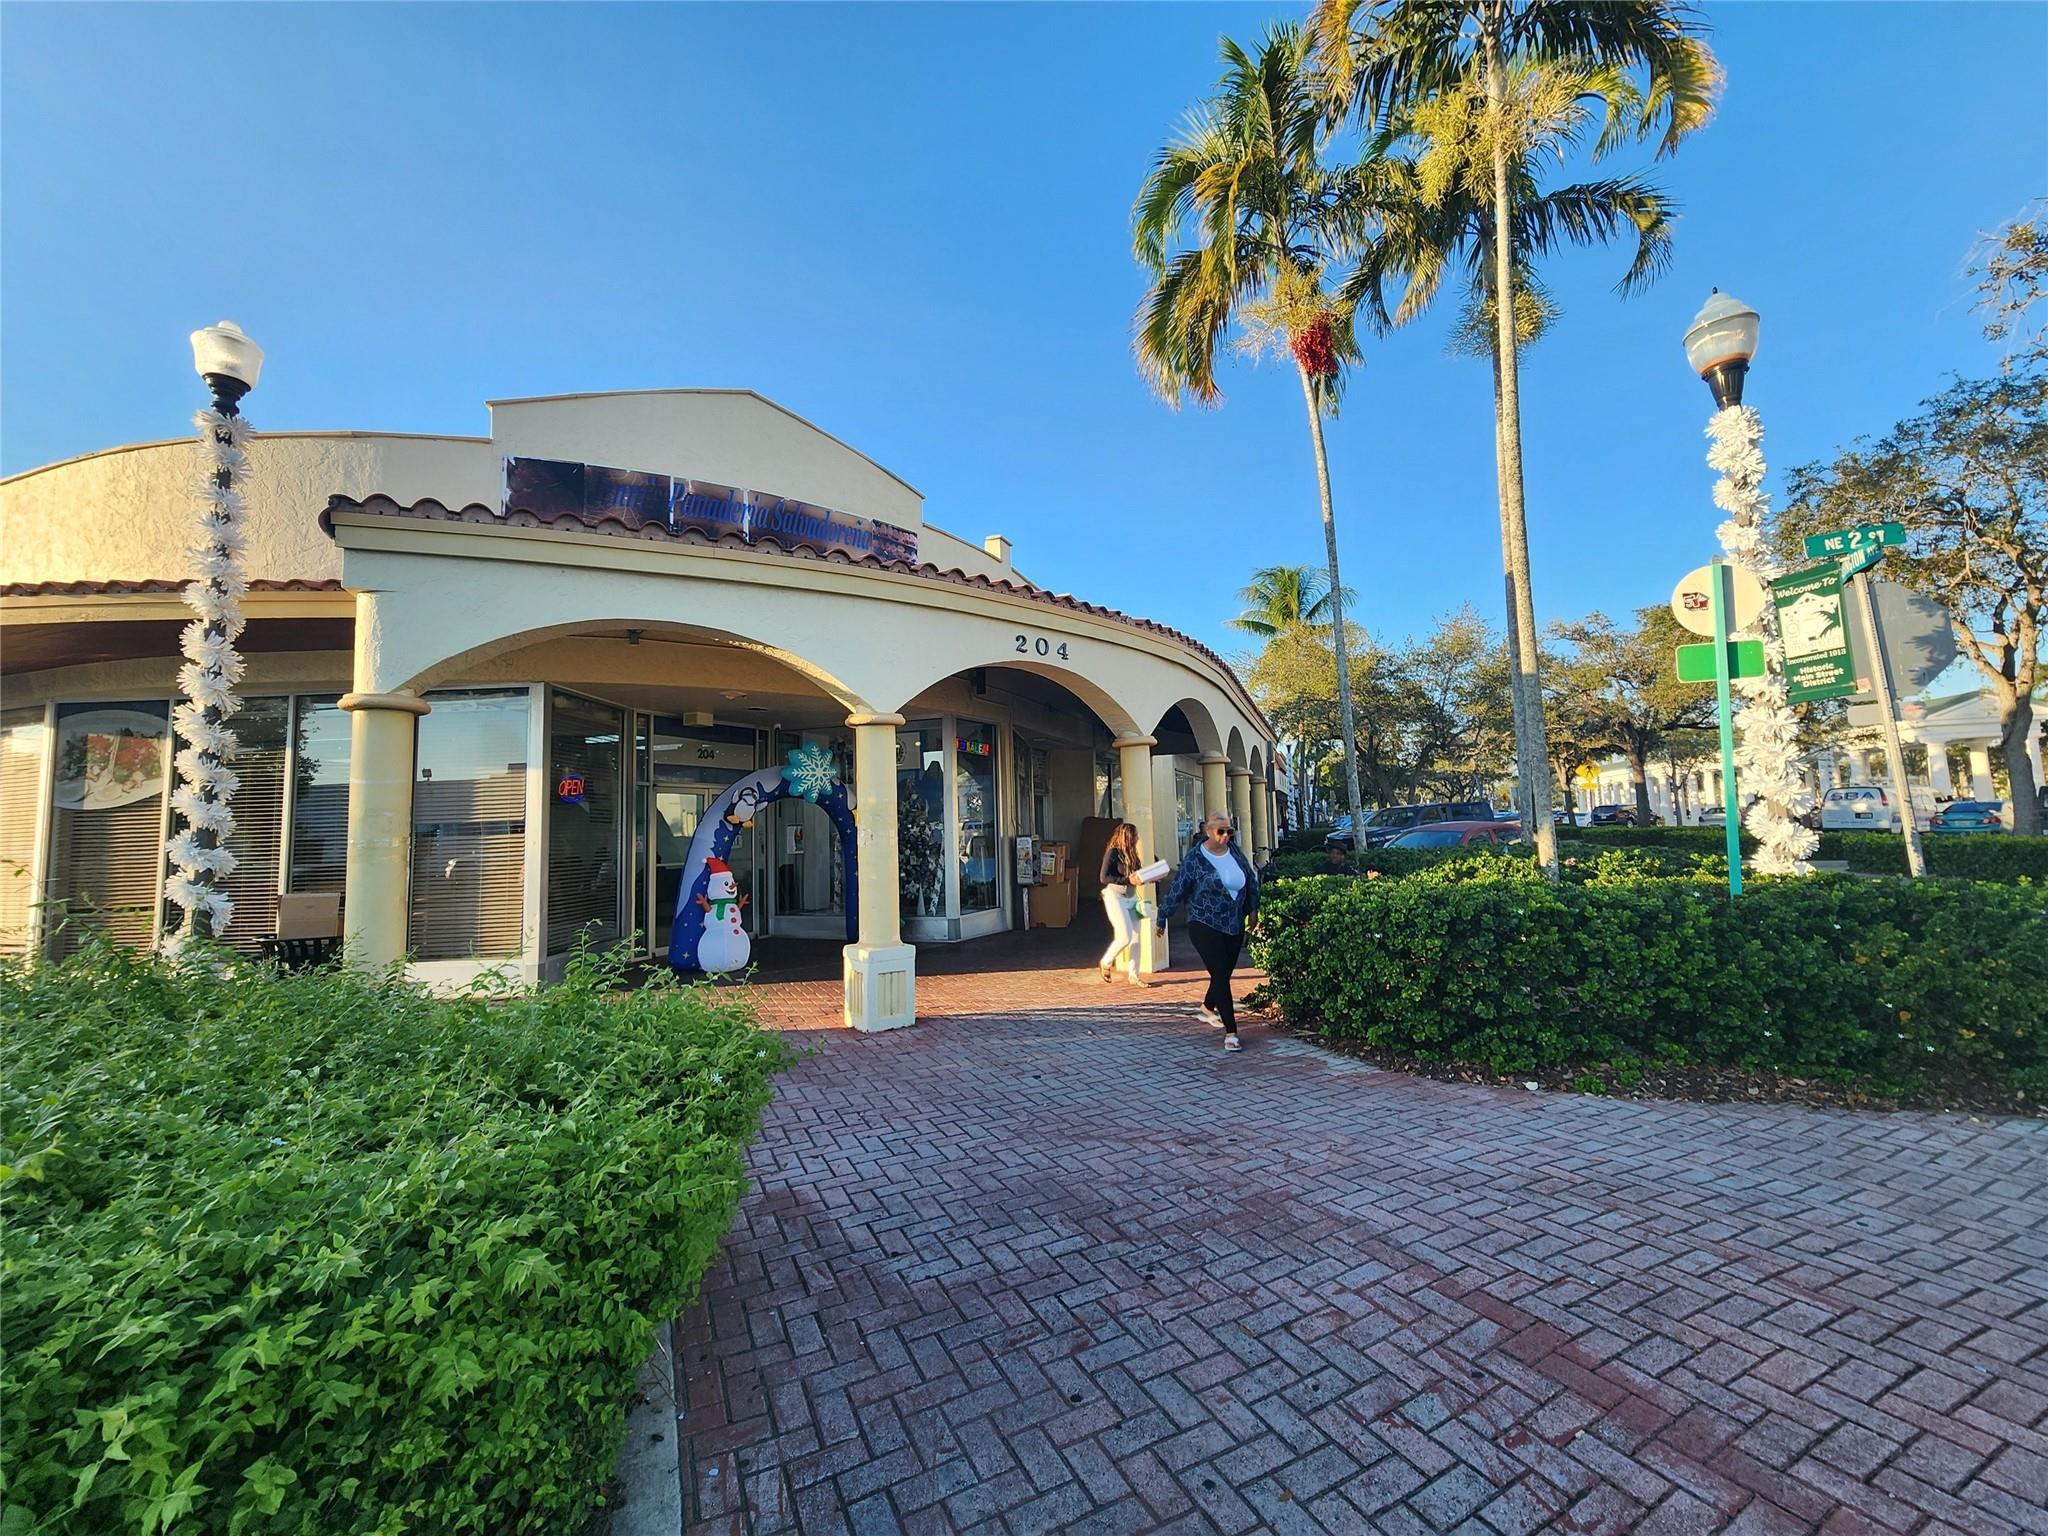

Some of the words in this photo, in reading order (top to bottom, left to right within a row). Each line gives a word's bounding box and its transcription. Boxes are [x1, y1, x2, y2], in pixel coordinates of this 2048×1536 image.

[1824, 537, 1844, 551] NE
[1848, 531, 1863, 550] 2
[1776, 582, 1822, 599] Welcome
[1822, 577, 1838, 587] To
[1015, 634, 1069, 660] 204
[1787, 651, 1828, 666] Incorporated
[1793, 673, 1815, 683] Main
[1815, 667, 1845, 678] Street
[1800, 663, 1834, 674] Historic
[1803, 676, 1836, 688] District
[697, 748, 715, 760] 204
[558, 779, 585, 796] OPEN
[1830, 792, 1875, 801] SBA
